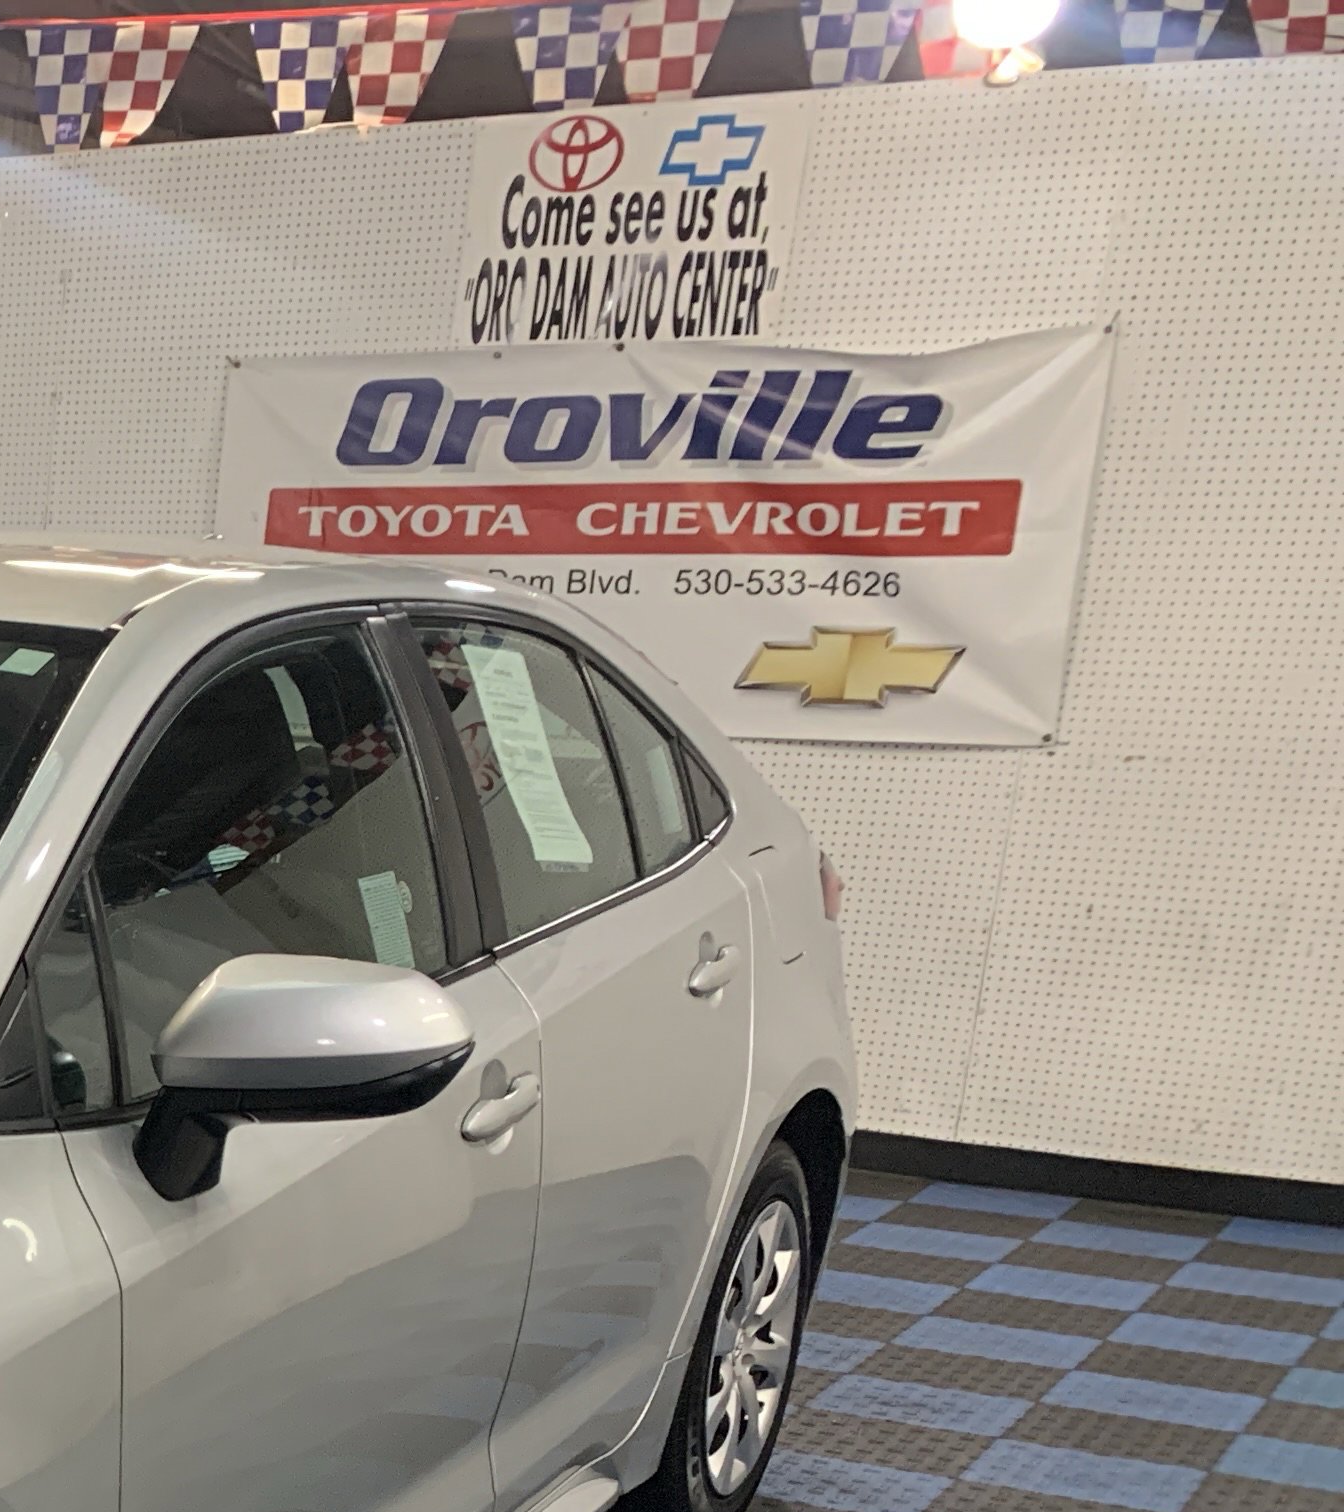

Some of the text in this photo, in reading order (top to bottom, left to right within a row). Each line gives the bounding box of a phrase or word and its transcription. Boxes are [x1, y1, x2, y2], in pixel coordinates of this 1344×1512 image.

[502, 171, 769, 249] Come see us at,
[529, 255, 593, 340] DAM
[594, 253, 669, 340] AUTO
[335, 370, 943, 467] Oroville
[299, 501, 980, 538] TOYOTA CHEVROLET
[566, 569, 641, 595] Blvd.
[674, 569, 902, 597] 530-533-4626
